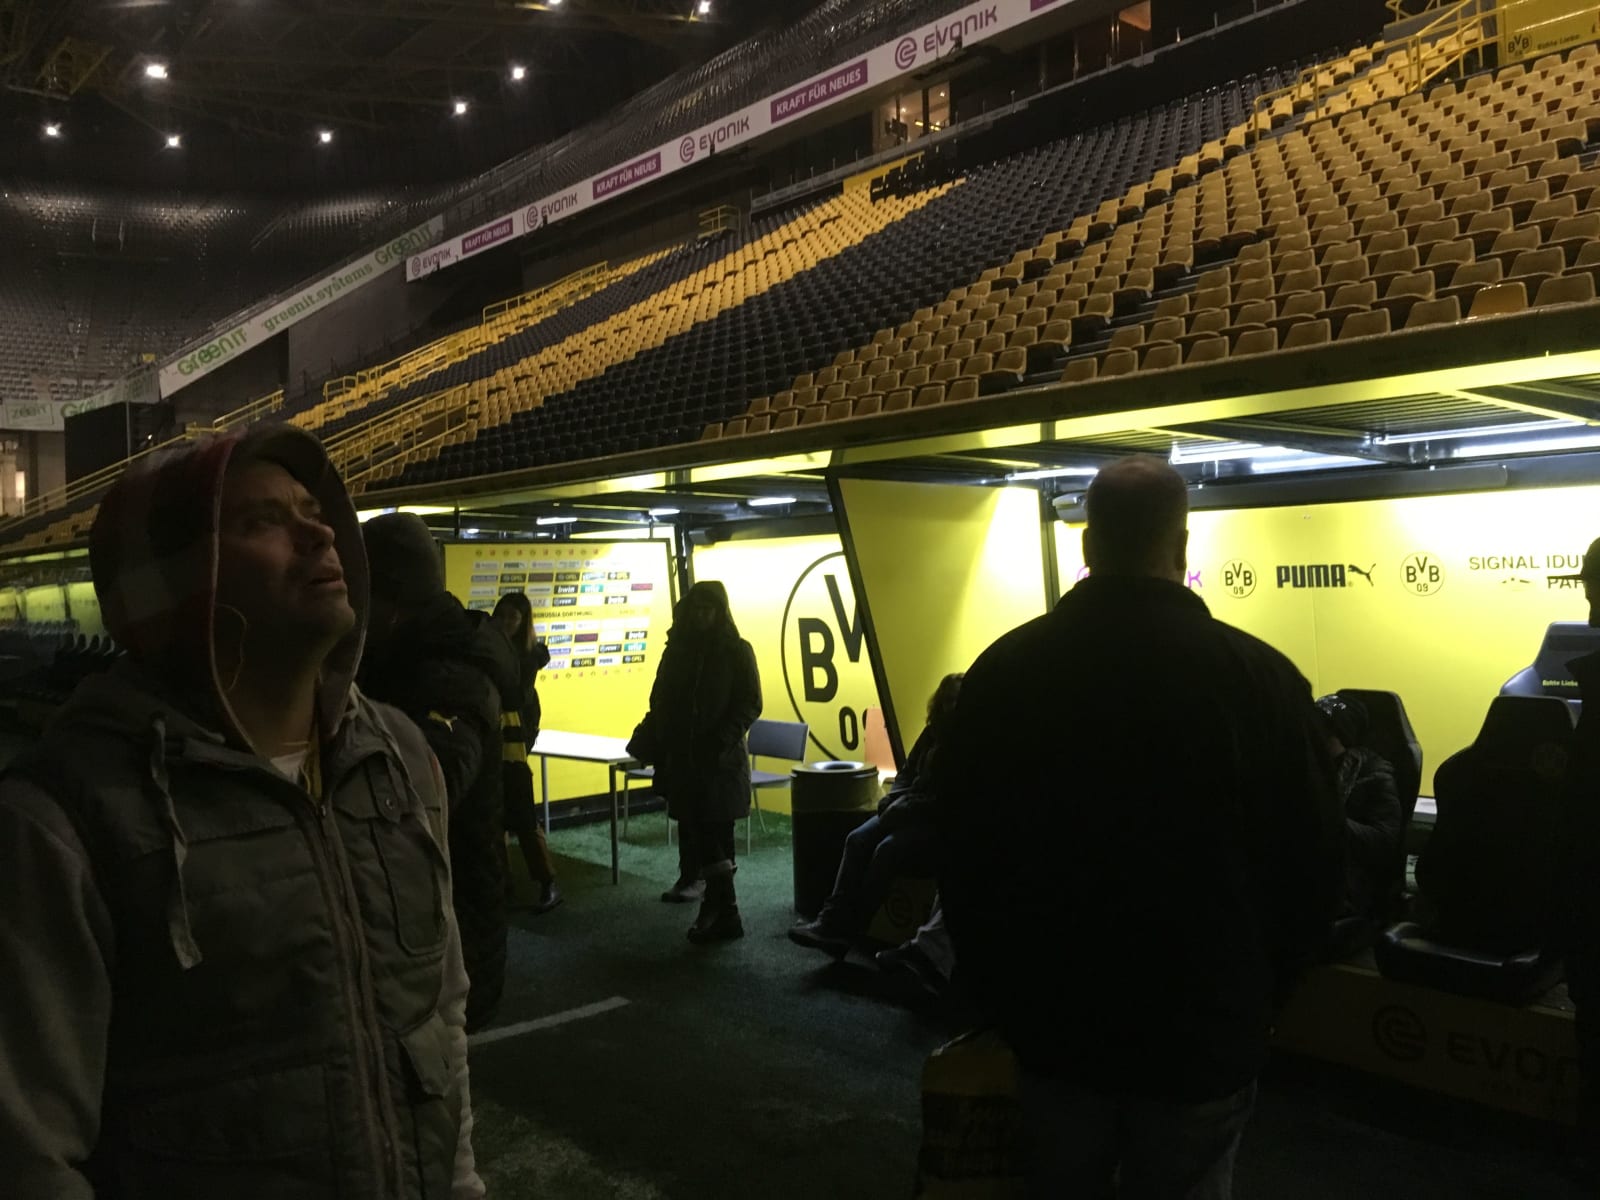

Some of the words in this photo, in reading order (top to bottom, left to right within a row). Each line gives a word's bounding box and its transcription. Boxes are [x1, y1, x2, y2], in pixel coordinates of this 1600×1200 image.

[923, 6, 998, 52] EVONIK
[1508, 34, 1530, 53] BVB
[776, 94, 806, 116] KRAFT
[808, 83, 827, 102] FÜR
[829, 68, 861, 91] NEUES
[699, 116, 750, 150] EVONIK
[596, 175, 618, 193] KRAFT
[619, 168, 633, 184] FÜR
[633, 160, 657, 177] NEUES
[541, 192, 578, 217] EVONIK
[422, 247, 451, 268] EVONIK
[1224, 562, 1253, 587] BVB
[1405, 556, 1440, 583] BVB
[1469, 555, 1540, 571] SIGNAL
[1546, 554, 1584, 569] IDU
[1276, 564, 1347, 589] PUMA
[1416, 583, 1428, 593] 09
[1233, 586, 1244, 595] 09
[798, 574, 864, 703] BV
